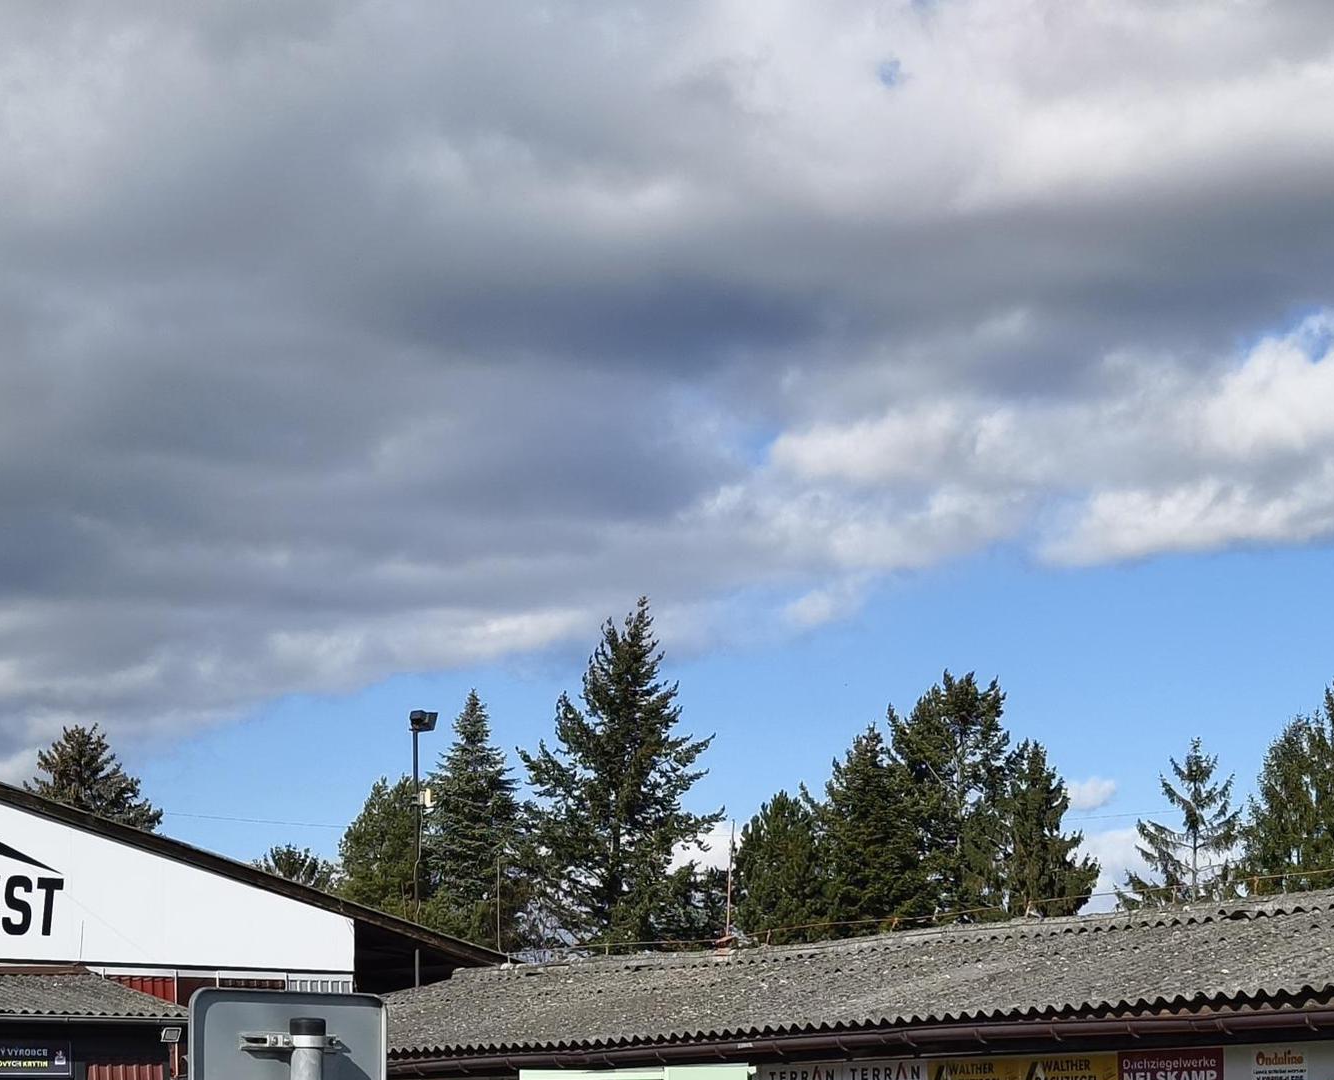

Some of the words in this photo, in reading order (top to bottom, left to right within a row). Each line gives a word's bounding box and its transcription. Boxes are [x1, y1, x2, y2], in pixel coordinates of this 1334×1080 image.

[948, 1063, 995, 1075] WALTHER
[1042, 1059, 1091, 1073] WALTHER
[1122, 1055, 1217, 1071] Dachziegelwerke
